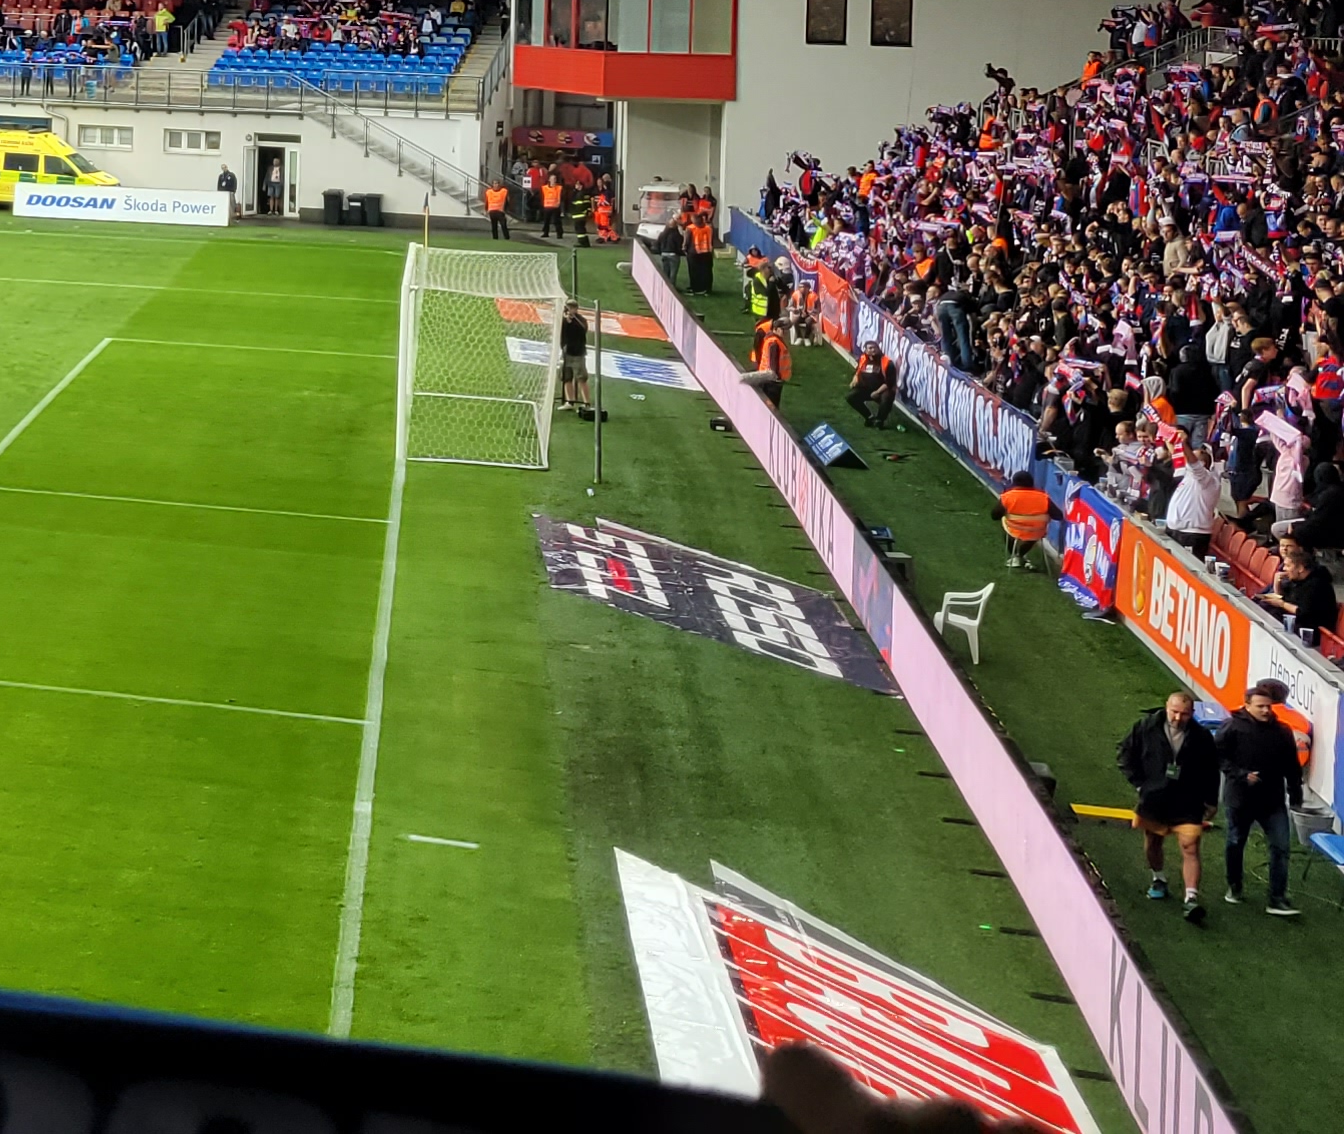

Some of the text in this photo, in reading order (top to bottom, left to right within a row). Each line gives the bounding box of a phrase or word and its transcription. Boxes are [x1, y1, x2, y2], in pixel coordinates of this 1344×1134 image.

[25, 193, 216, 216] DOOSAN Škoda Power
[1148, 556, 1231, 690] BETANO
